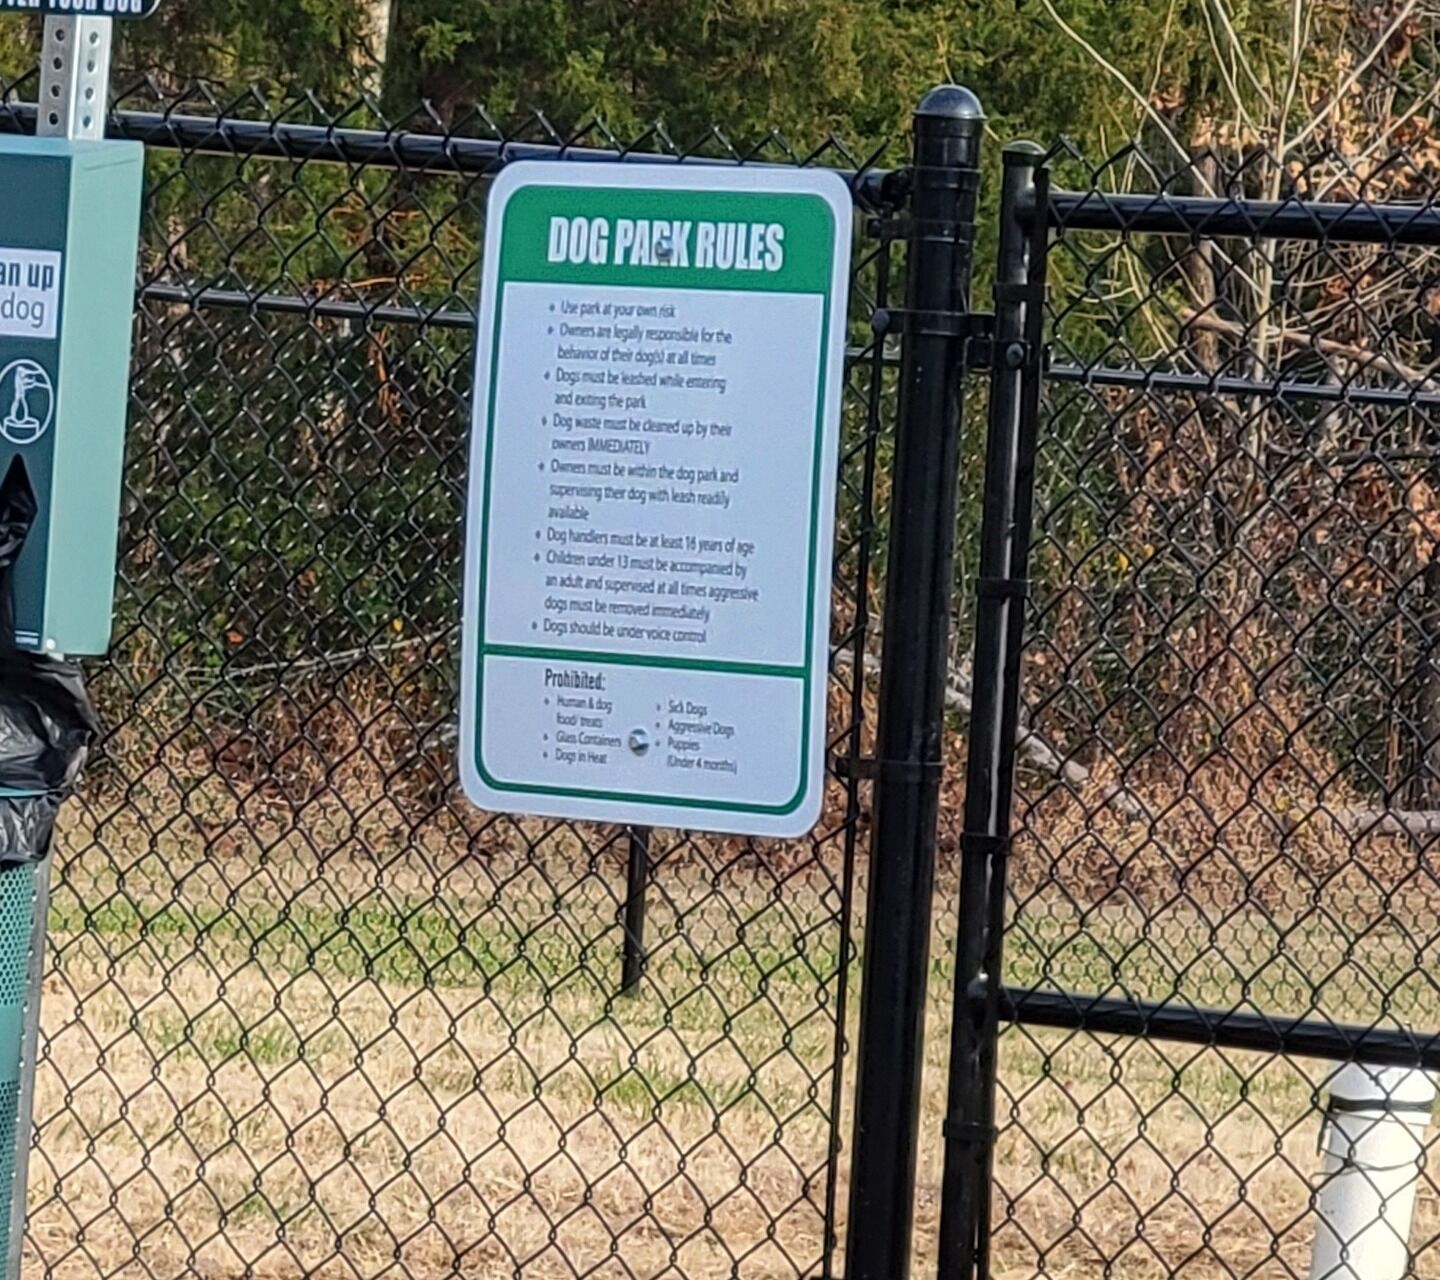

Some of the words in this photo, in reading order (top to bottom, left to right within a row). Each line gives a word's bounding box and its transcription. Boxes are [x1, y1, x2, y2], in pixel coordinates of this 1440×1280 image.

[548, 216, 609, 264] DOG
[614, 219, 692, 267] PARK
[695, 221, 784, 271] RULES
[28, 262, 54, 291] up
[1, 292, 45, 327] dog
[561, 300, 577, 314] Use
[580, 302, 600, 317] park
[603, 304, 610, 314] at
[613, 305, 635, 318] your
[637, 305, 657, 317] own
[659, 304, 675, 318] risk
[560, 323, 596, 337] Owners
[597, 327, 611, 338] are
[614, 324, 643, 342] legally
[646, 327, 699, 342] responsible
[701, 327, 715, 342] for
[716, 330, 732, 344] the
[558, 345, 597, 360] behavior
[600, 348, 610, 361] of
[612, 348, 633, 362] their
[666, 352, 677, 364] at
[678, 351, 688, 364] all
[691, 353, 716, 366] times
[556, 367, 580, 385] Dogs
[582, 371, 605, 384] must
[607, 370, 619, 384] be
[622, 370, 657, 386] leashed
[659, 373, 684, 387] while
[686, 375, 726, 394] entering
[555, 392, 573, 405] and
[575, 393, 606, 409] exiting
[608, 394, 624, 408] the
[626, 394, 647, 410] park
[553, 413, 573, 431] Dog
[575, 415, 601, 428] waste
[604, 417, 626, 429] must
[629, 418, 640, 430] be
[643, 419, 679, 433] cleaned
[682, 423, 694, 436] up
[696, 422, 707, 437] by
[710, 422, 732, 436] their
[552, 439, 585, 452] owners
[588, 437, 651, 454] IMMEDIATELY
[551, 458, 585, 473] Owners
[588, 462, 611, 475] must
[613, 463, 625, 476] be
[628, 464, 657, 478] within
[659, 466, 674, 479] the
[676, 466, 695, 484] dog
[697, 468, 719, 485] park
[720, 469, 739, 483] and
[549, 484, 602, 502] supervising
[604, 486, 626, 500] their
[628, 487, 647, 504] dog
[649, 488, 669, 502] with
[671, 488, 696, 503] leash
[698, 489, 730, 509] readily
[548, 505, 589, 520] available
[547, 527, 567, 545] Dog
[569, 529, 608, 545] handlers
[611, 533, 634, 546] must
[636, 532, 648, 547] be
[649, 536, 659, 547] at
[661, 534, 683, 550] least
[698, 538, 723, 554] years
[725, 538, 736, 552] of
[737, 541, 755, 557] age
[546, 550, 585, 566] Children
[587, 553, 614, 567] under
[617, 554, 629, 568] 13
[631, 557, 654, 569] must
[655, 559, 668, 571] be
[670, 559, 734, 576] accompanied
[735, 562, 747, 580] by
[545, 575, 558, 586] an
[559, 574, 583, 589] adult
[585, 576, 602, 589] and
[605, 578, 655, 594] supervised
[657, 581, 665, 594] at
[667, 580, 679, 595] all
[681, 581, 707, 597] times
[709, 586, 759, 602] aggressive
[545, 595, 568, 613] dogs
[569, 598, 592, 610] must
[595, 598, 607, 613] be
[609, 600, 650, 616] removed
[652, 603, 710, 623] immediately
[544, 618, 568, 636] Dogs
[570, 620, 601, 635] should
[603, 622, 615, 637] be
[617, 623, 645, 638] under
[645, 624, 670, 640] voice
[673, 627, 707, 643] control
[545, 668, 606, 691] Prohibited:
[557, 696, 586, 708] Human
[588, 697, 594, 709] &
[596, 698, 612, 713] dog
[668, 699, 684, 713] Sick
[686, 700, 707, 718] Dogs
[580, 716, 603, 728] treats
[668, 718, 712, 736] Aggressive
[713, 722, 735, 739] Dogs
[556, 730, 577, 743] Glass
[578, 731, 621, 747] Containers
[668, 737, 700, 751] Puppies
[555, 748, 576, 765] Dogs
[578, 753, 586, 762] in
[588, 751, 607, 765] Heat
[667, 754, 693, 769] (Under
[704, 758, 737, 774] months)
